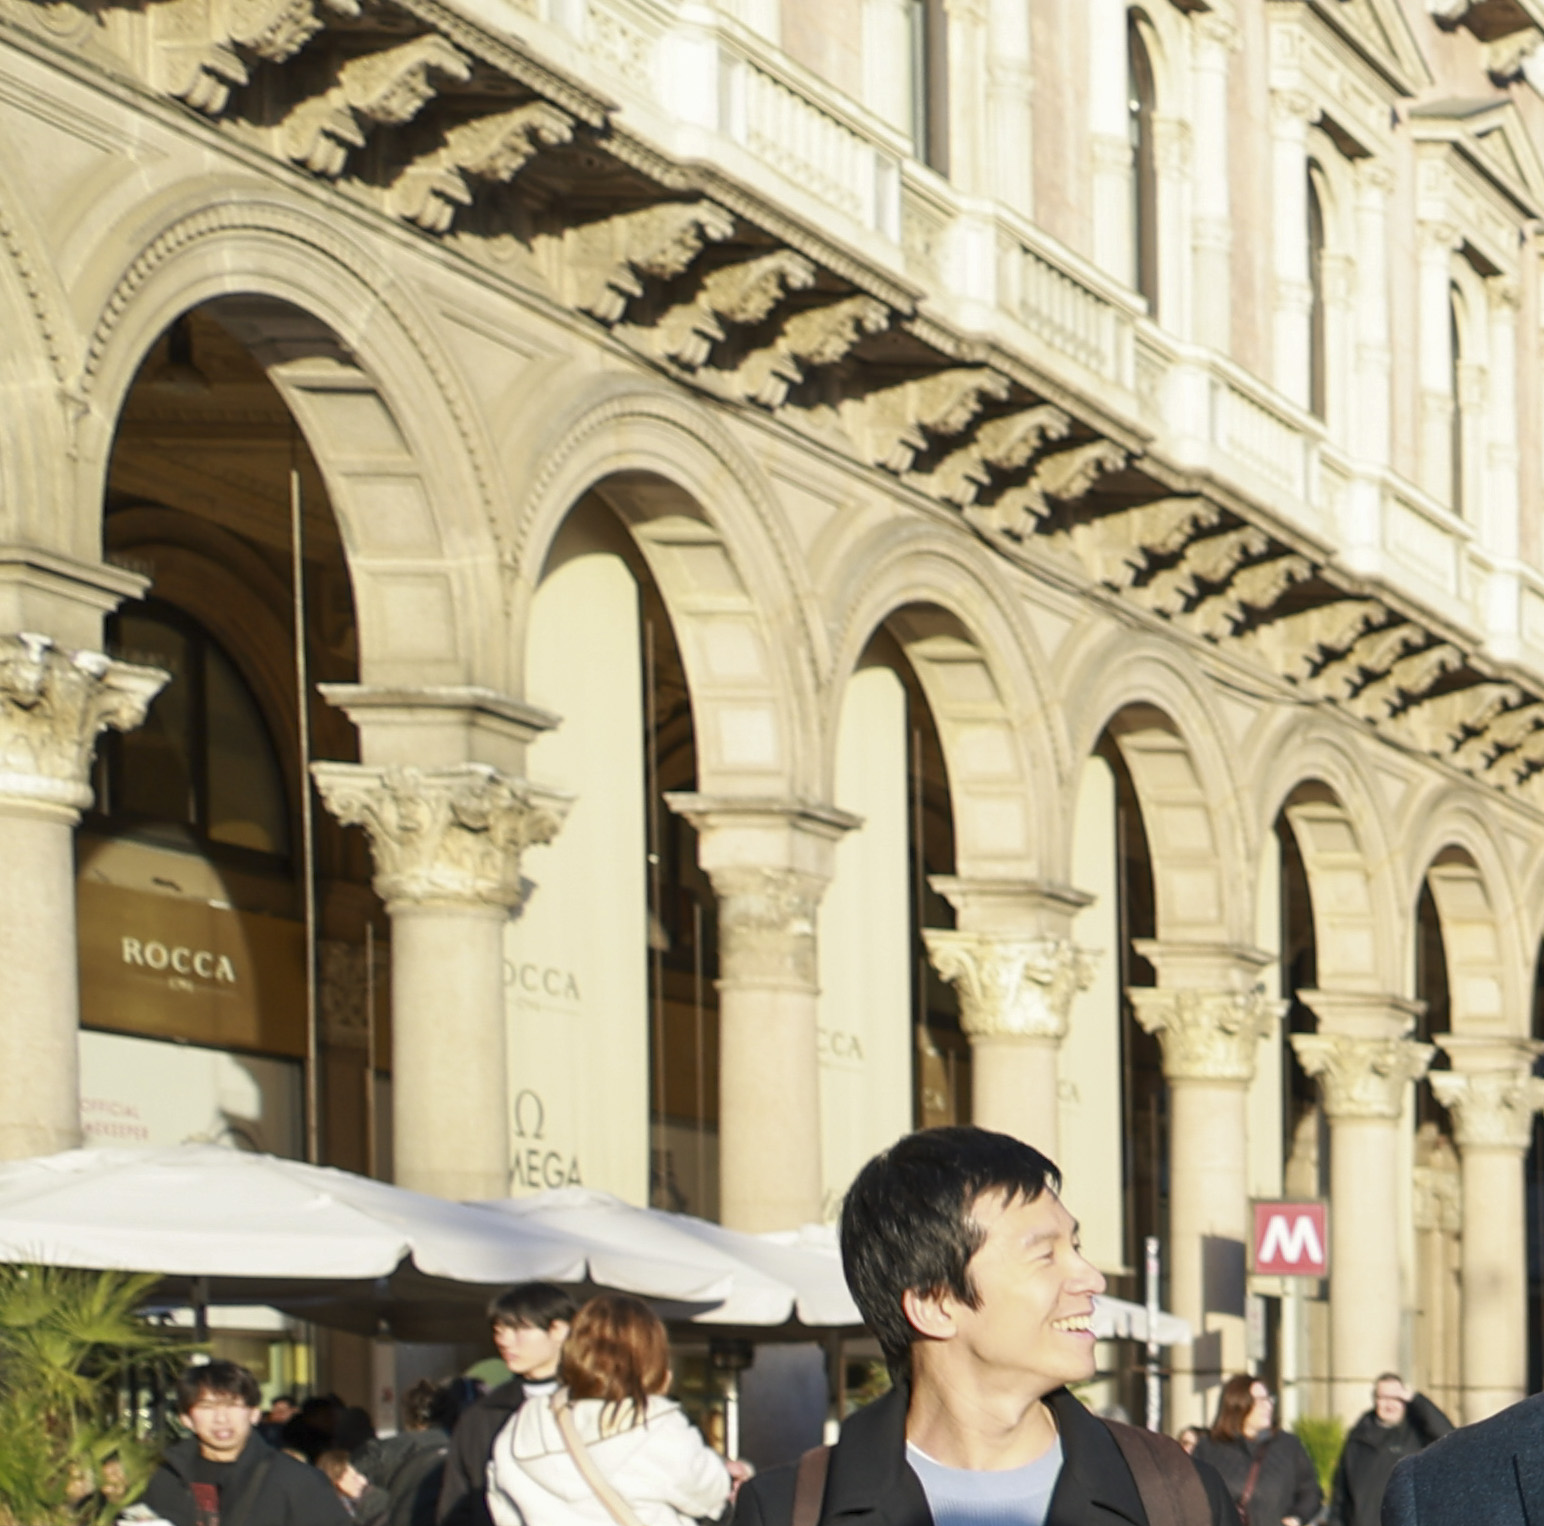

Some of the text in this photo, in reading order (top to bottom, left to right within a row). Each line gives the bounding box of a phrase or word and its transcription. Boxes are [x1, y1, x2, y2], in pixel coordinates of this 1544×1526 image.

[121, 936, 236, 983] ROCCA
[502, 958, 580, 999] OCCA
[506, 1149, 583, 1189] MEGA
[1258, 1214, 1323, 1264] M
